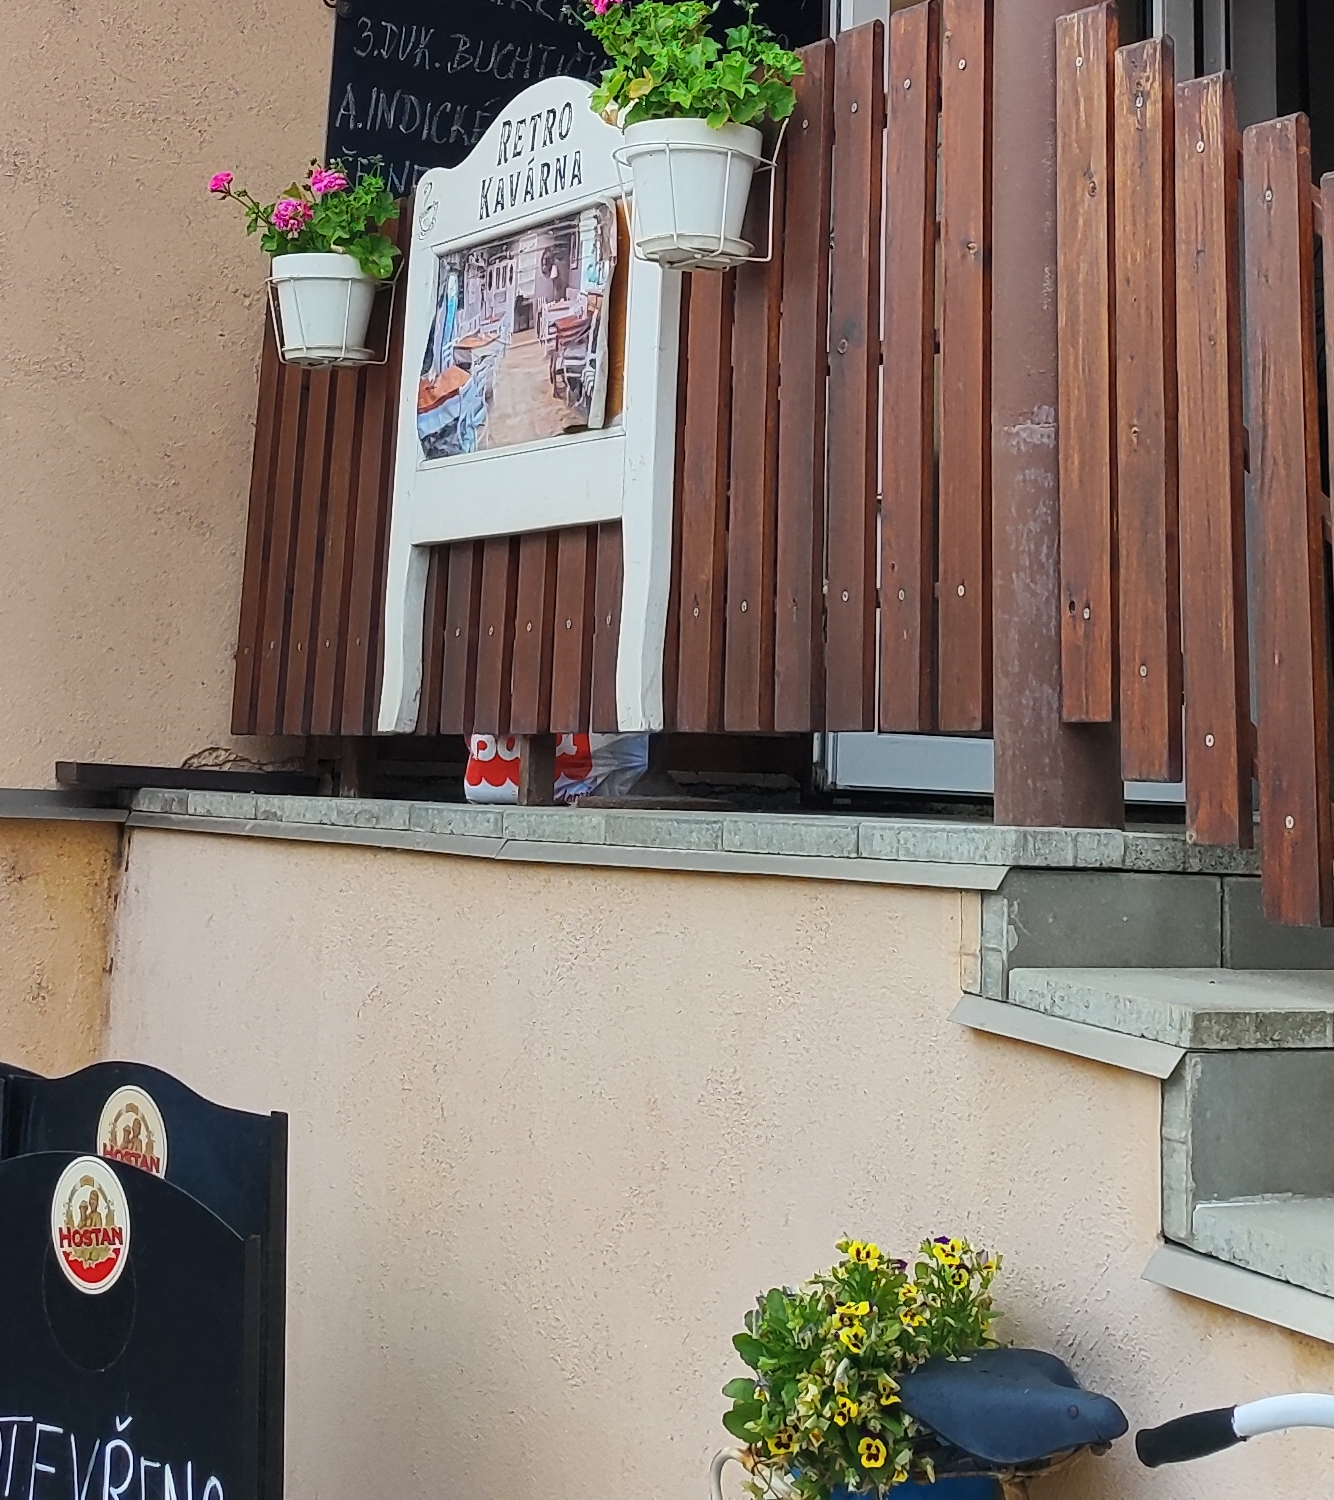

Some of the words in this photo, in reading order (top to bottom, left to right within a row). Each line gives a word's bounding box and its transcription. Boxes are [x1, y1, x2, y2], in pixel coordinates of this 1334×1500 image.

[447, 33, 609, 85] BUCHTIČK
[497, 101, 573, 167] RETRO
[479, 150, 583, 221] KAVÁRNA
[102, 1142, 161, 1173] HOSTAN
[58, 1226, 124, 1249] HOSTAN
